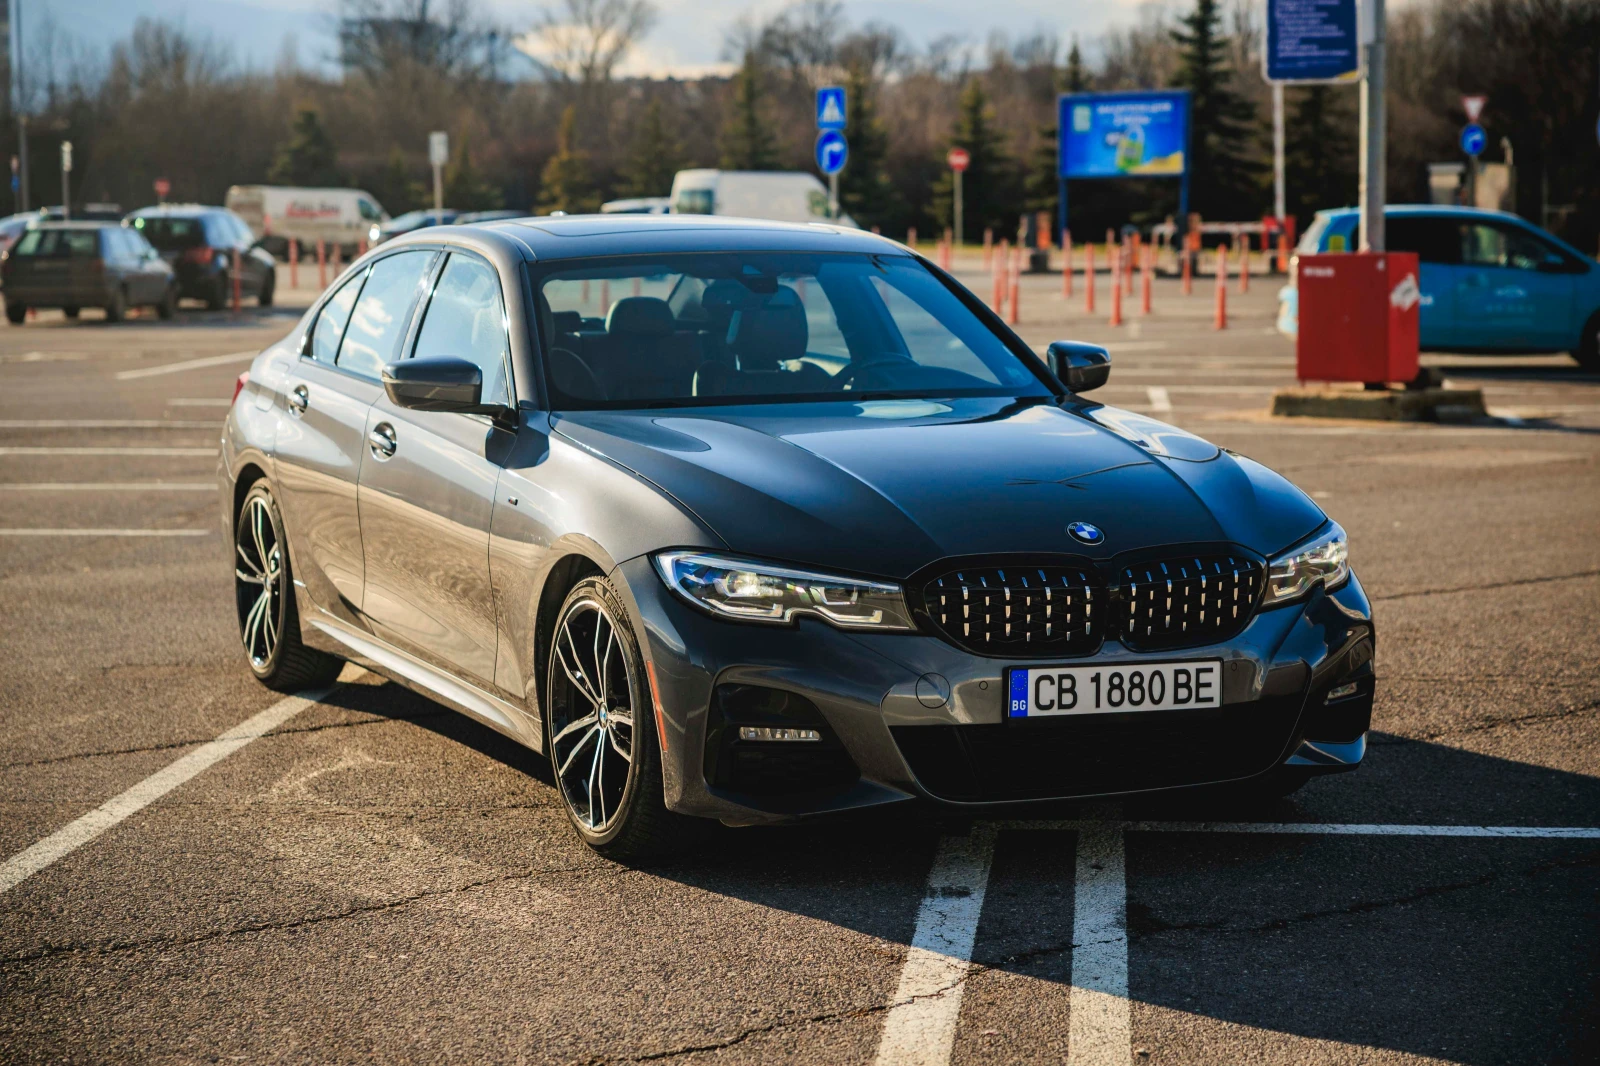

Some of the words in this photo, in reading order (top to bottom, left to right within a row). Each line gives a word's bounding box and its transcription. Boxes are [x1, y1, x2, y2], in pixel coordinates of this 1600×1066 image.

[1034, 673, 1078, 711] CB
[1090, 670, 1166, 708] 1880
[1173, 667, 1215, 705] BE
[1011, 699, 1027, 711] BG
